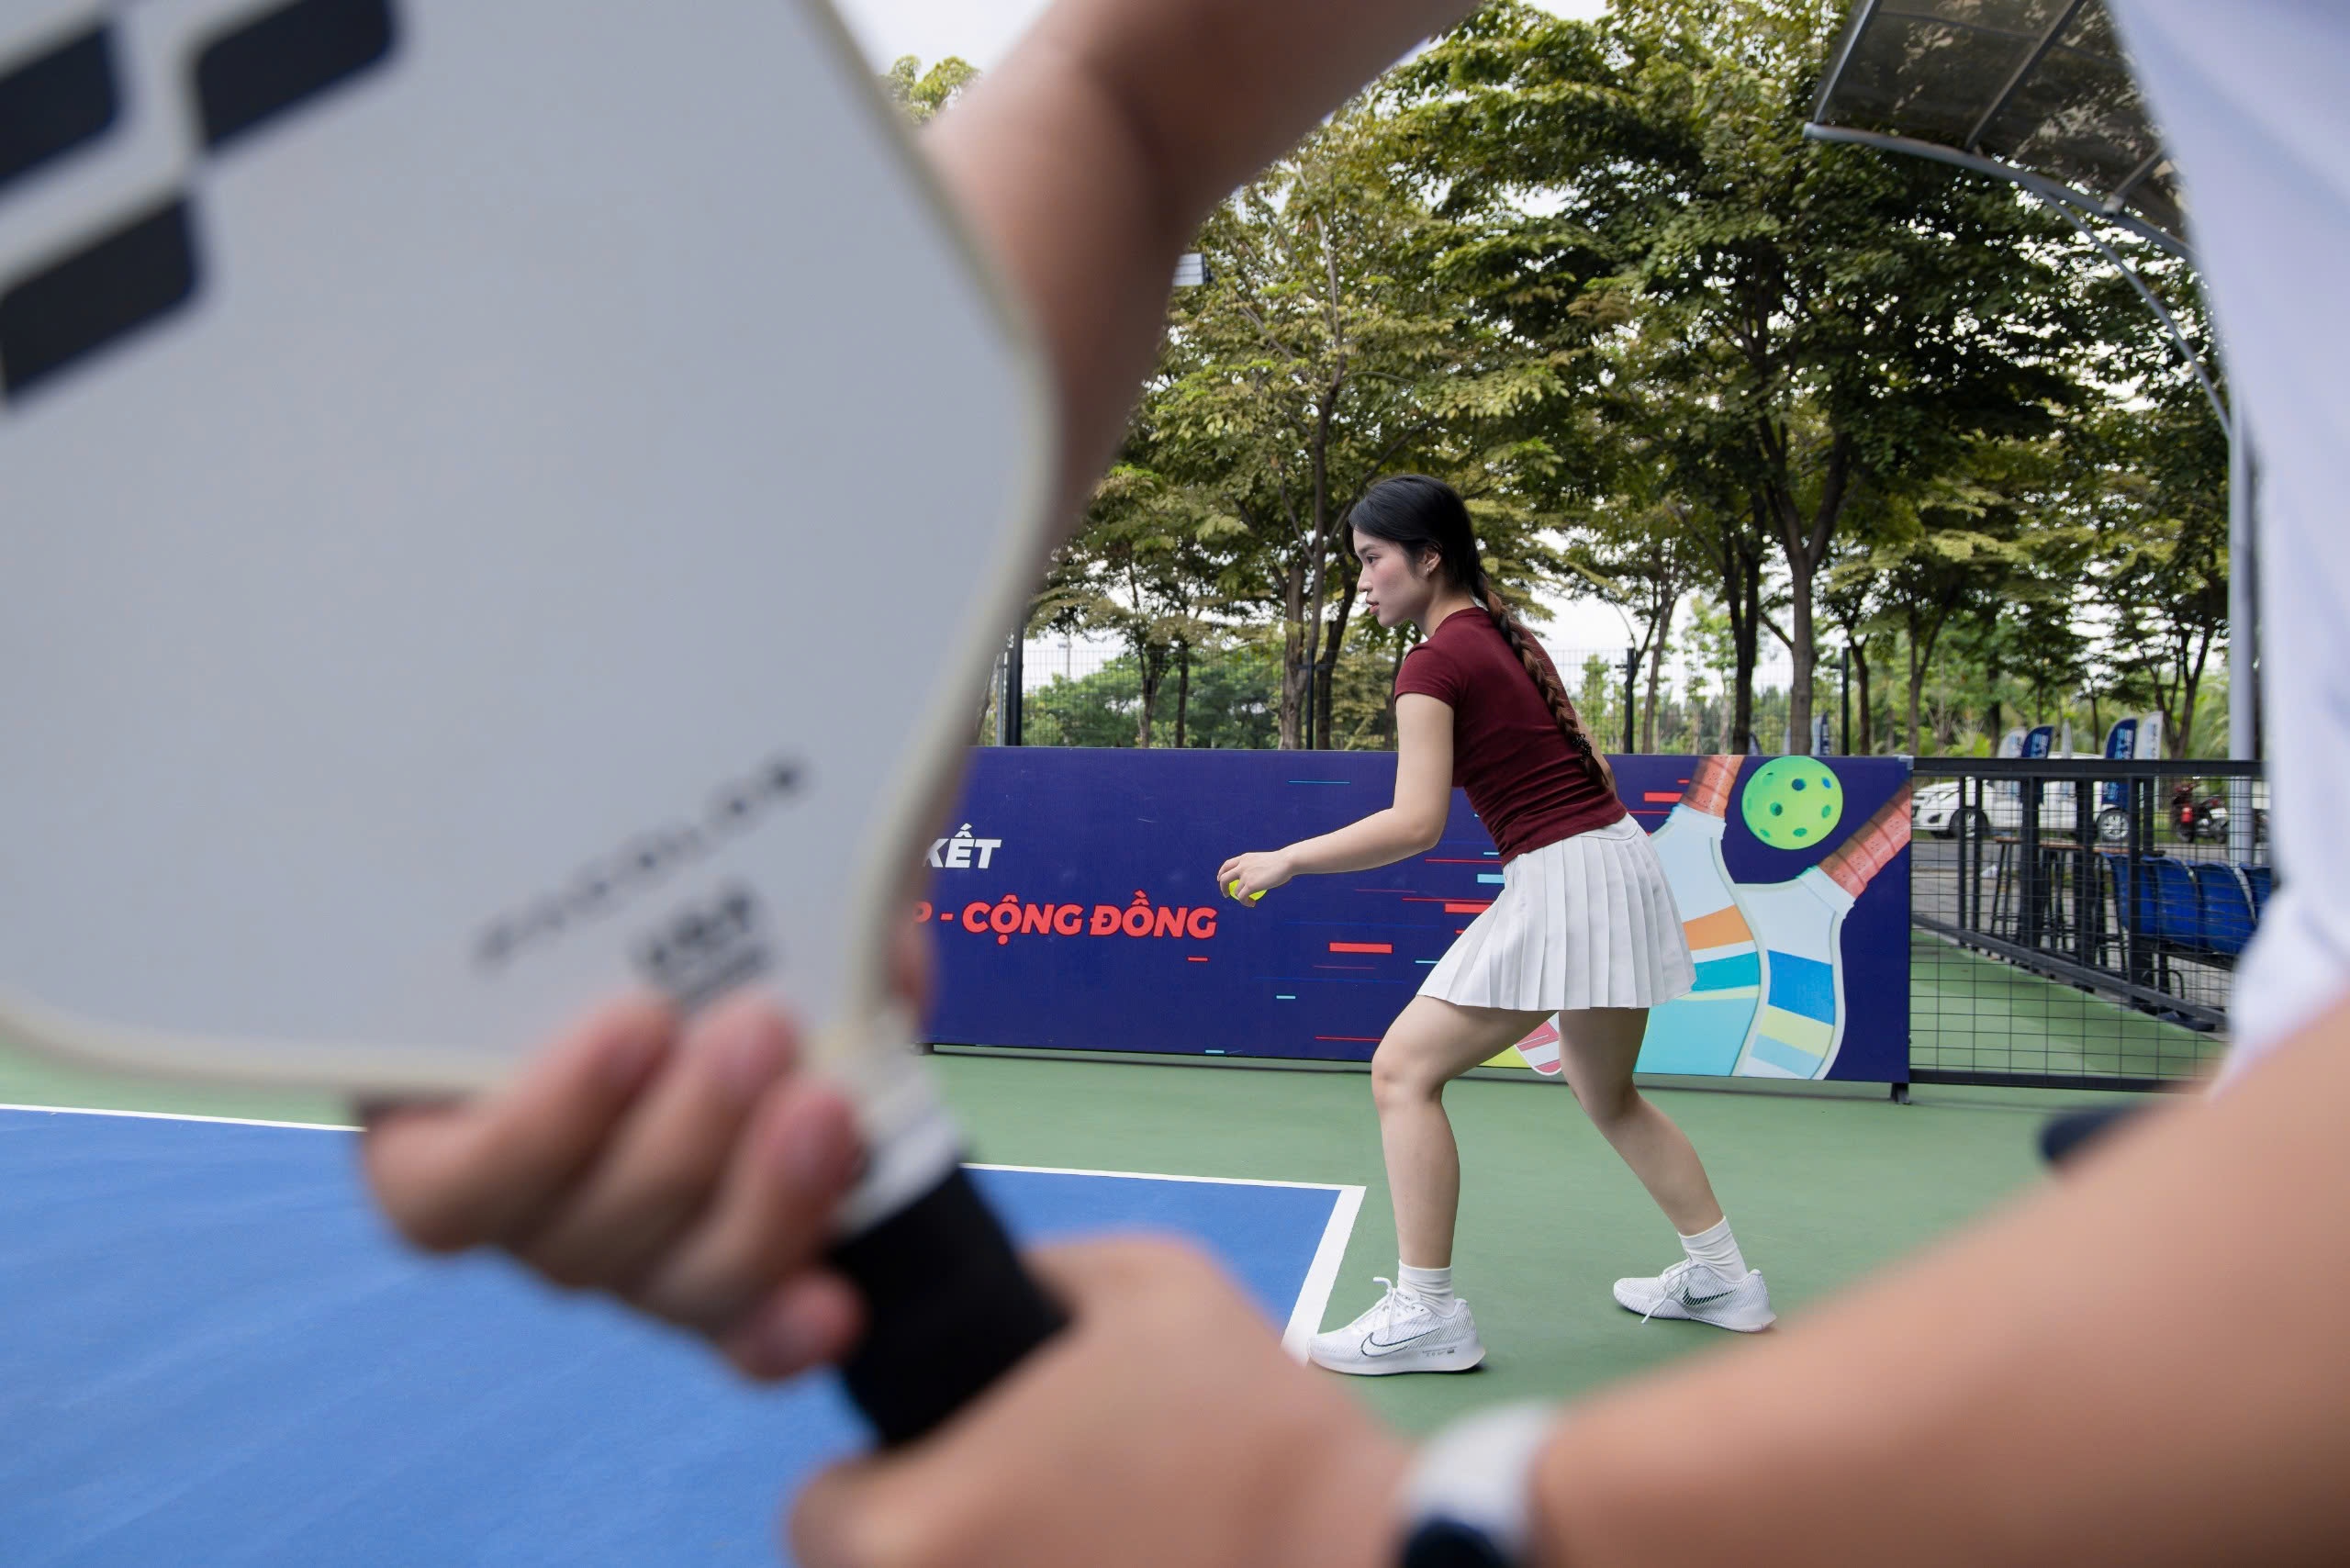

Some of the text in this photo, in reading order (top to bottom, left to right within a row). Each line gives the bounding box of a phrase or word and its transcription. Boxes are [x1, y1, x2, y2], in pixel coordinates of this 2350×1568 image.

[923, 823, 1002, 868] KẾT
[940, 912, 954, 922] -
[962, 893, 1084, 945] CỘNG
[1090, 890, 1218, 939] ĐỒNG
